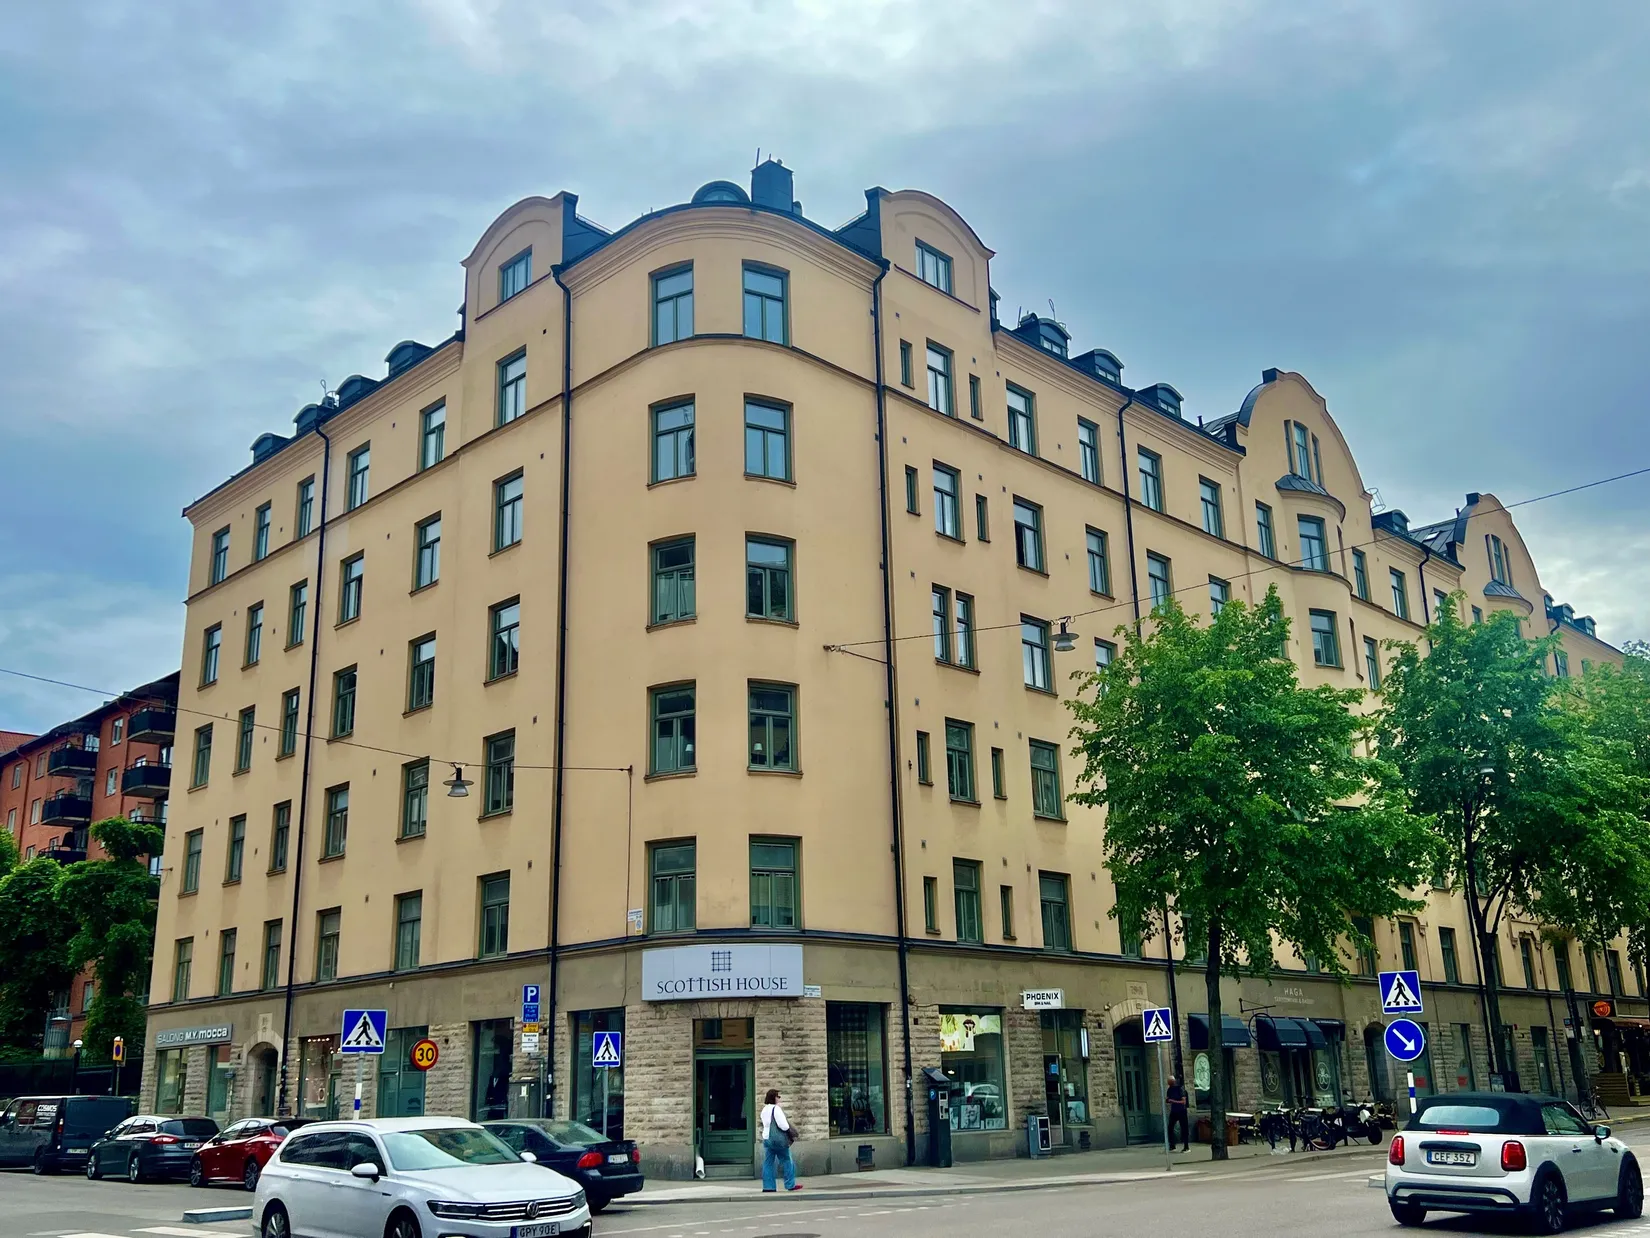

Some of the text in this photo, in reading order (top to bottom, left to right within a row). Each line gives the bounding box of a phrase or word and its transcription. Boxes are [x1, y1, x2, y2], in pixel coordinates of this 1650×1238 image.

[656, 977, 789, 994] SCOTTISH HOUSE
[1283, 987, 1304, 997] HAGA
[527, 986, 537, 1002] P
[1026, 992, 1059, 1001] PHOENIX
[198, 1027, 228, 1040] mocca
[417, 1047, 435, 1062] 30
[1434, 1152, 1451, 1161] CEF
[520, 1225, 556, 1238] GPY 90E
